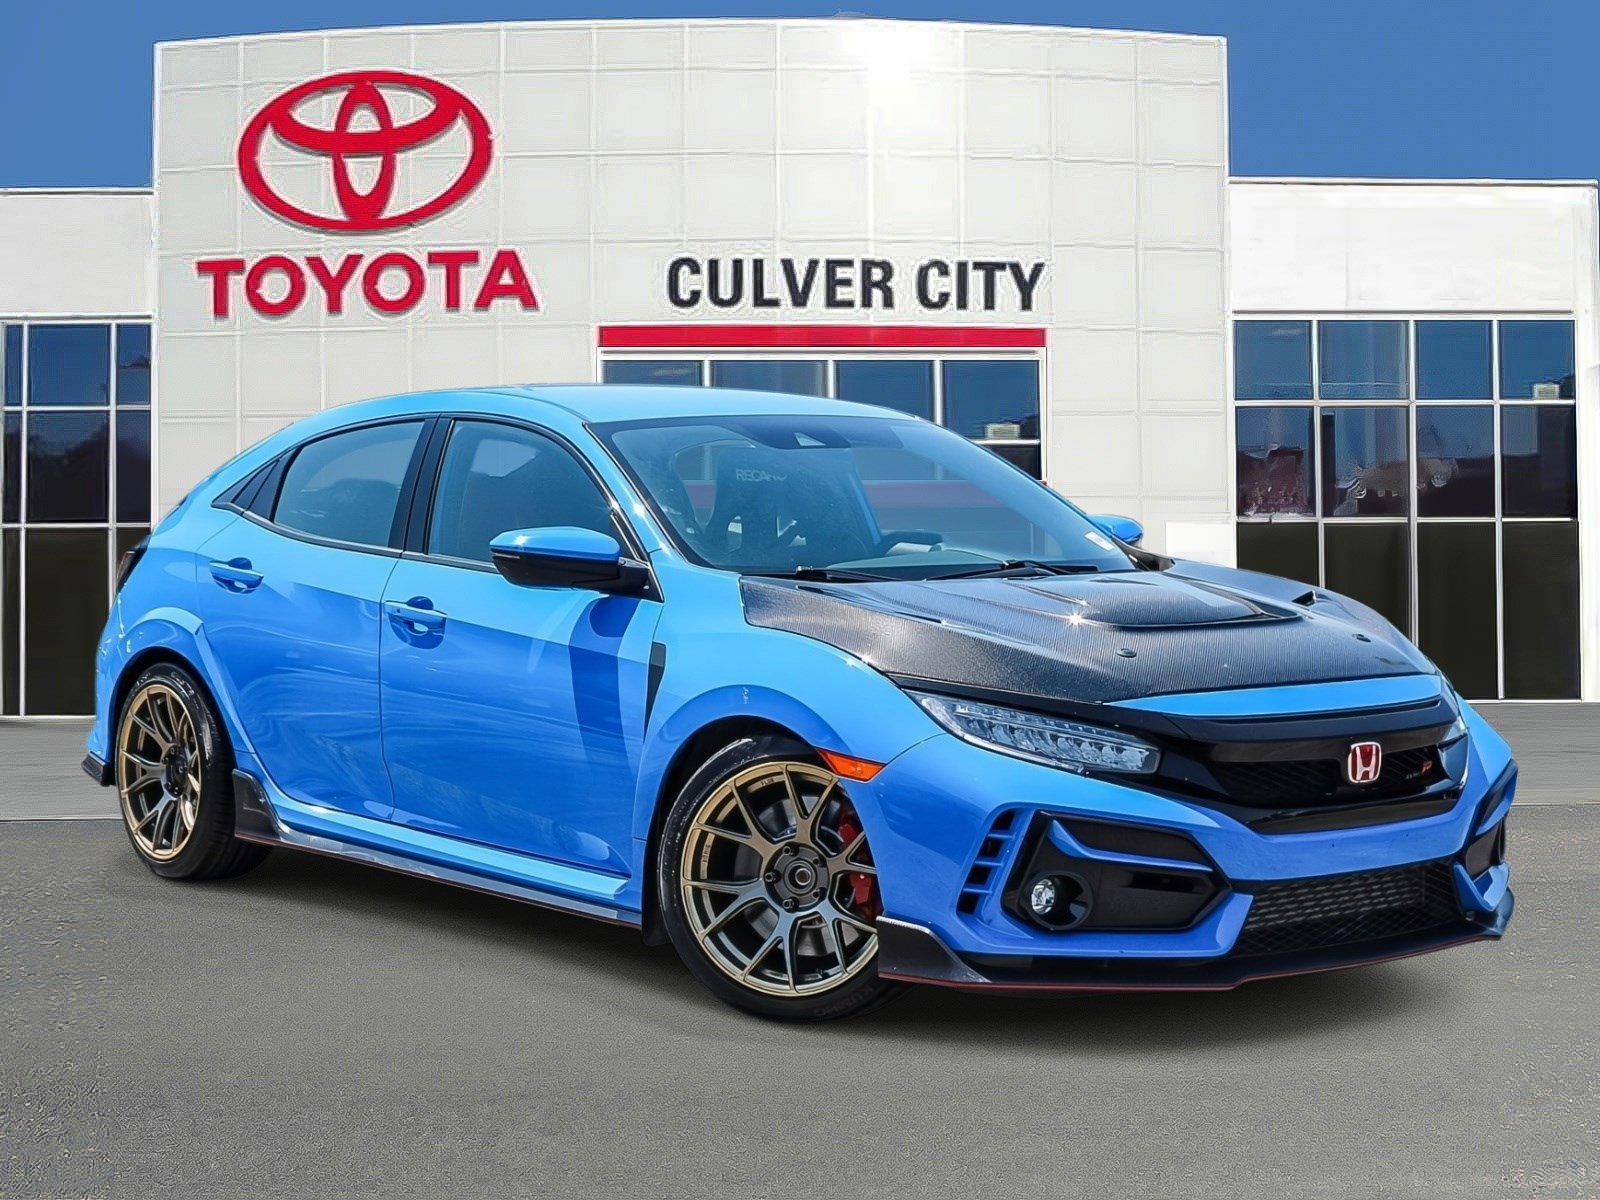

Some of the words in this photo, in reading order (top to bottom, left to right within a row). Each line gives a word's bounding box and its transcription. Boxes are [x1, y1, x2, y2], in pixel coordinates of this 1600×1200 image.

[196, 249, 538, 317] TOYOTA
[667, 257, 895, 309] CULVER
[916, 259, 1046, 312] CITY
